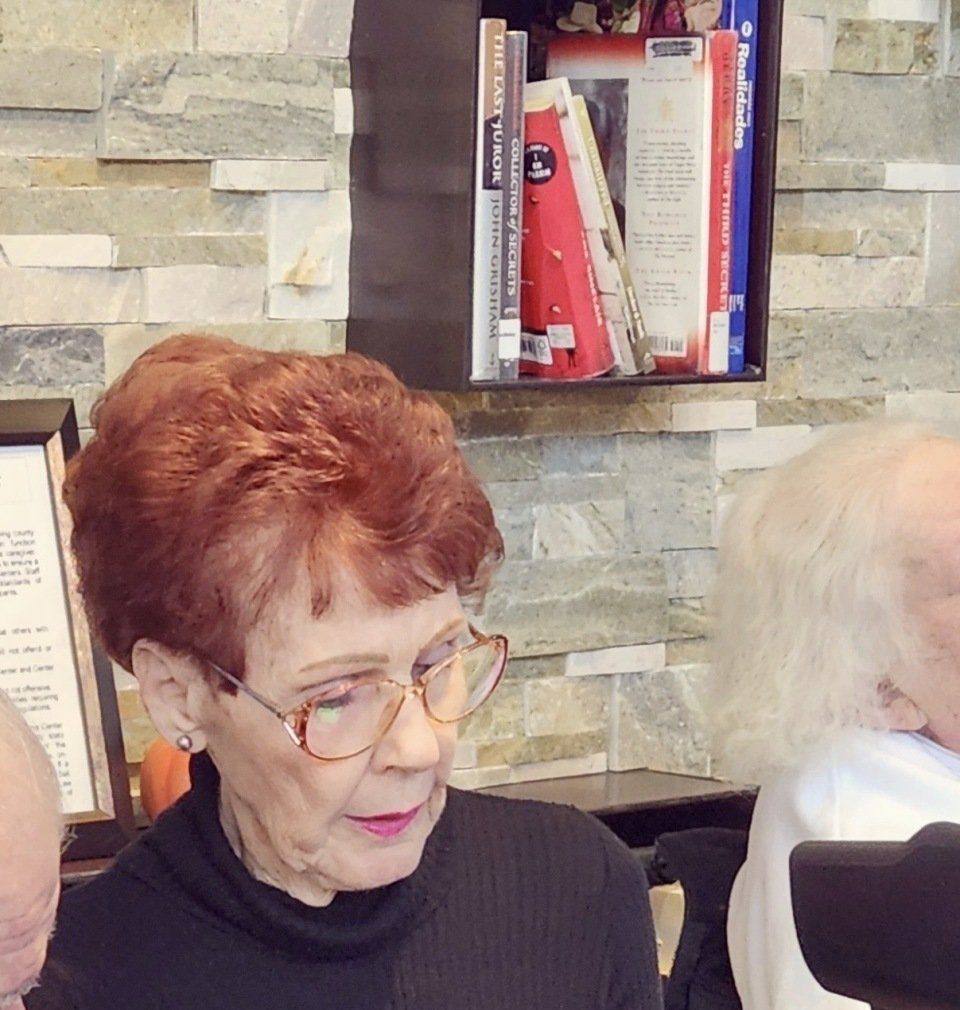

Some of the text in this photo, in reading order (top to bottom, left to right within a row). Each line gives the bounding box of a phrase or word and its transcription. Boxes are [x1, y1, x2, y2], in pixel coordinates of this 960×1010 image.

[491, 33, 504, 185] THE LAST JUROR
[733, 42, 750, 150] Realidades
[509, 137, 520, 216] COLLECTOR
[721, 192, 731, 247] THIRD
[488, 197, 500, 340] JOHN GRISHAM
[507, 233, 518, 297] SECRETS
